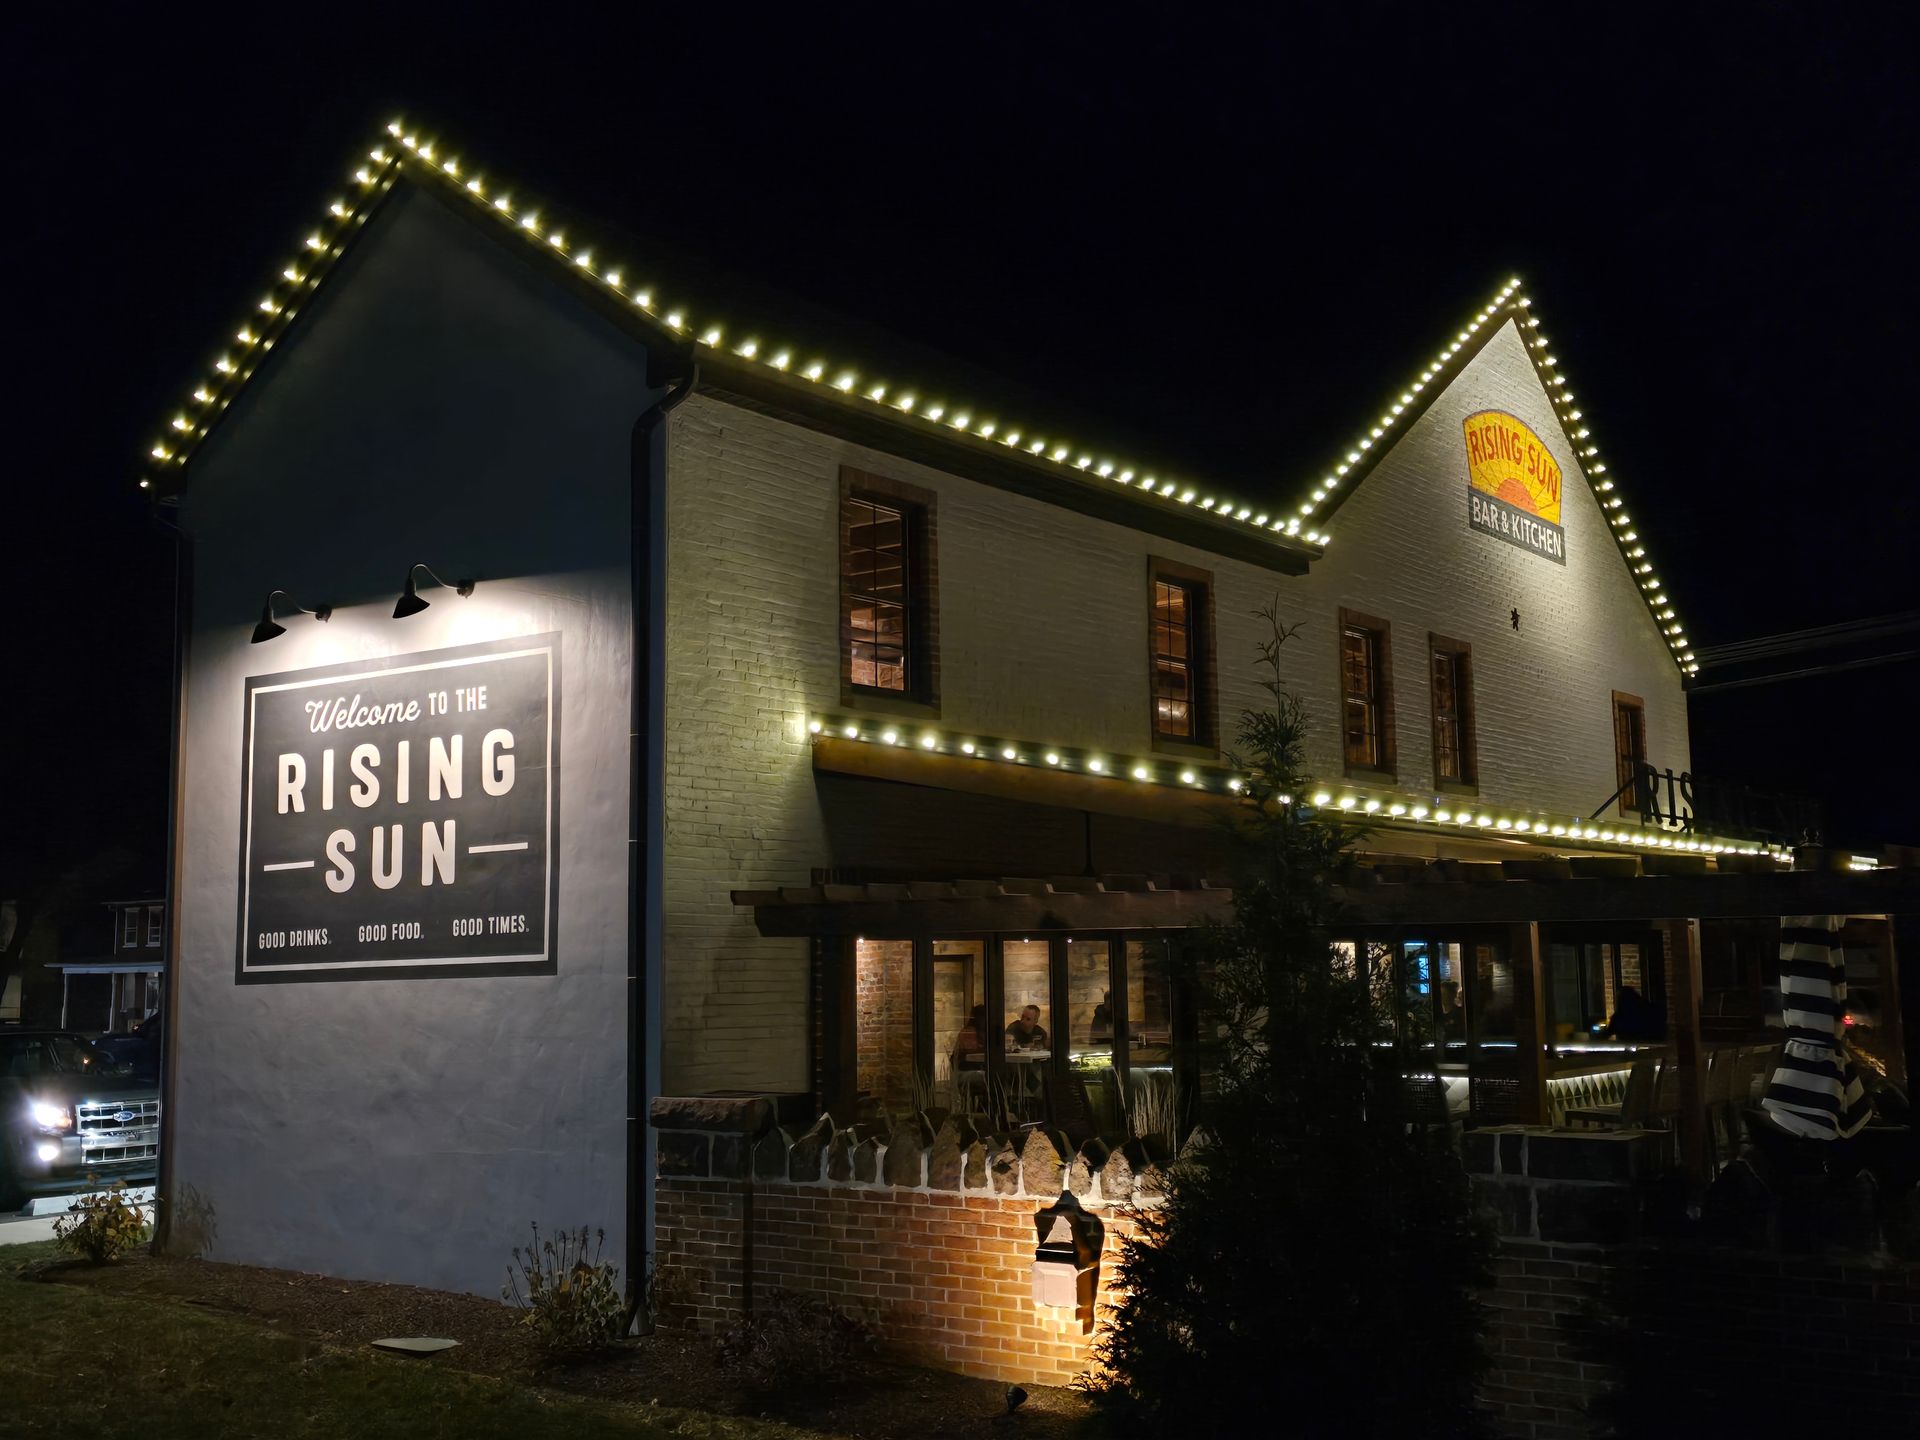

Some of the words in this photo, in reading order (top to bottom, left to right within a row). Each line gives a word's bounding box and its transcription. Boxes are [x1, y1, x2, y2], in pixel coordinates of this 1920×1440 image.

[1469, 425, 1523, 466] RISING
[1527, 443, 1558, 503] SUN
[1472, 496, 1499, 531] BAR
[1501, 510, 1510, 535] &
[1511, 514, 1562, 558] KITCHEN
[305, 694, 421, 733] Welcome
[428, 692, 448, 717] TO
[455, 685, 488, 712] THE
[277, 728, 516, 815] RISING
[324, 819, 456, 894] SUN
[258, 931, 286, 950] GOOD
[289, 928, 332, 947] DRINKS.
[358, 924, 387, 943] GOOD
[391, 922, 425, 941] FOOD.
[452, 917, 483, 937] GOOD
[487, 914, 530, 934] TIMES.
